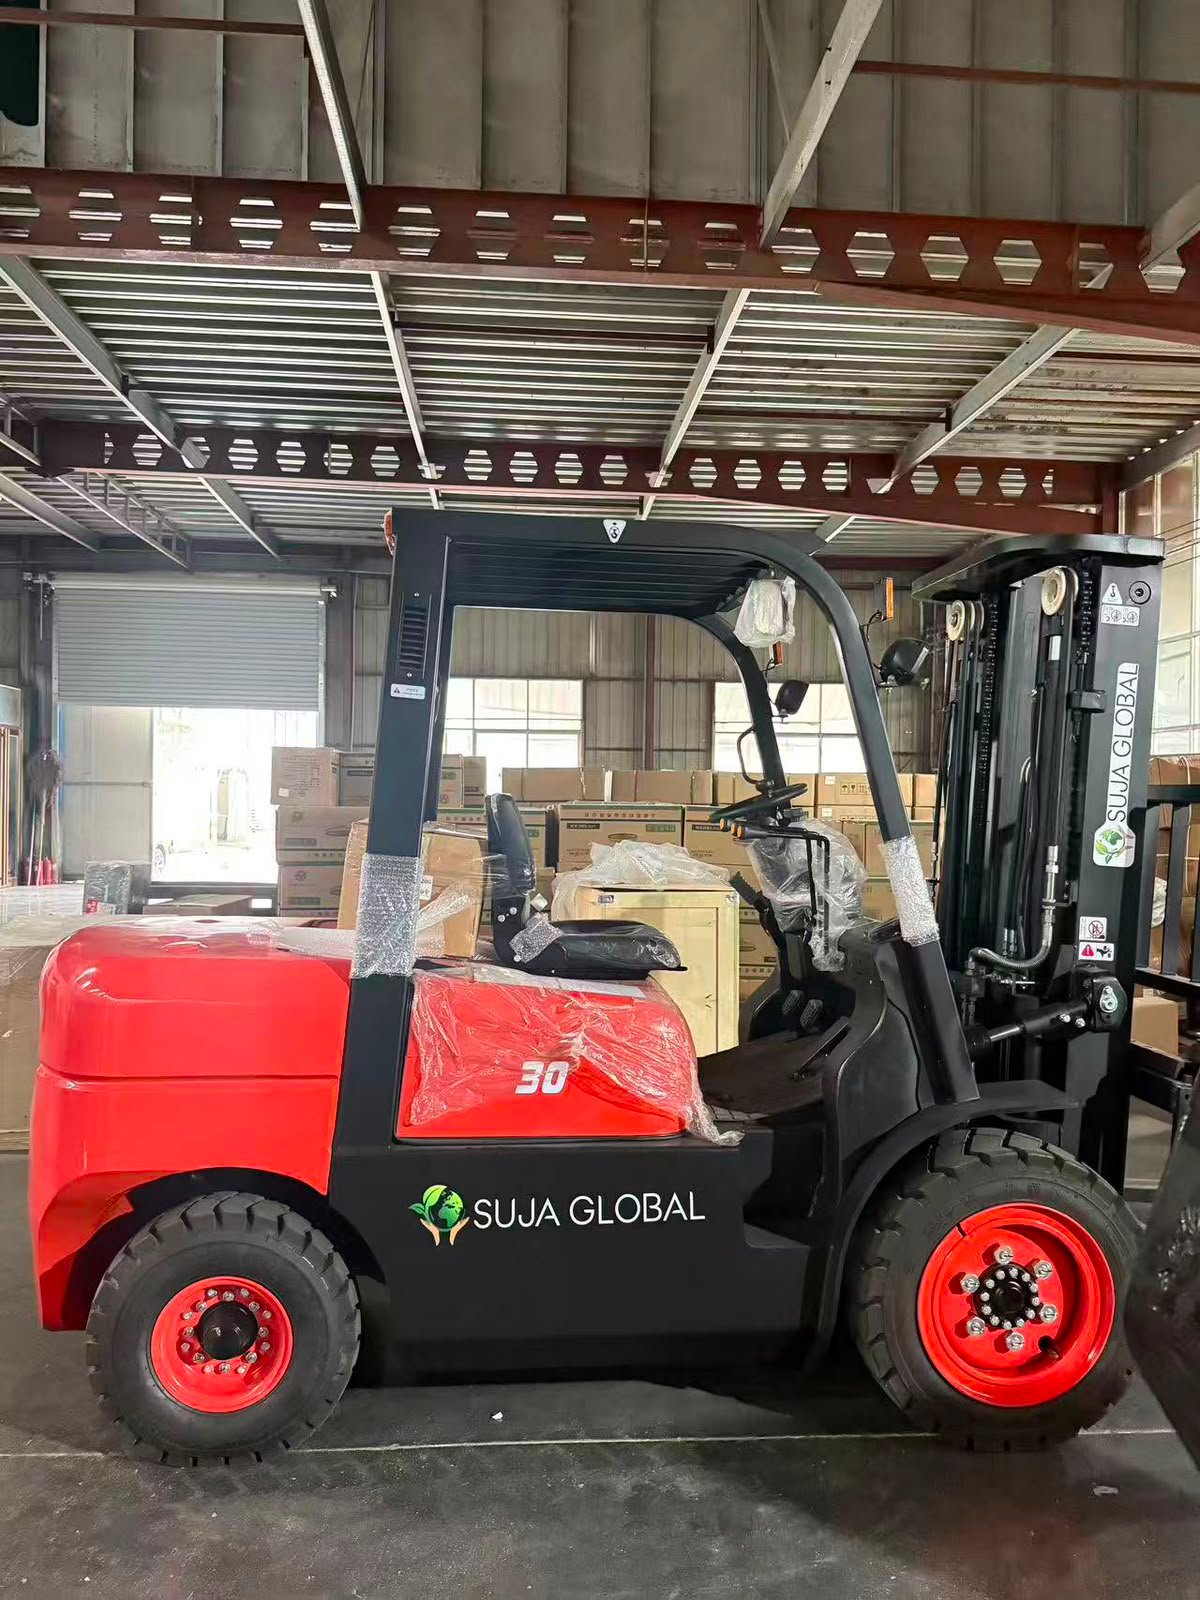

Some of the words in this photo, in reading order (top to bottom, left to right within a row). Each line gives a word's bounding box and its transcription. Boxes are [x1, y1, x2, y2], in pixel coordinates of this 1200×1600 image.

[1112, 664, 1139, 758] GLOBAL
[1107, 764, 1130, 823] SUJA
[514, 1061, 570, 1094] 30
[473, 1197, 561, 1230] SUJA
[569, 1191, 706, 1226] GLOBAL
